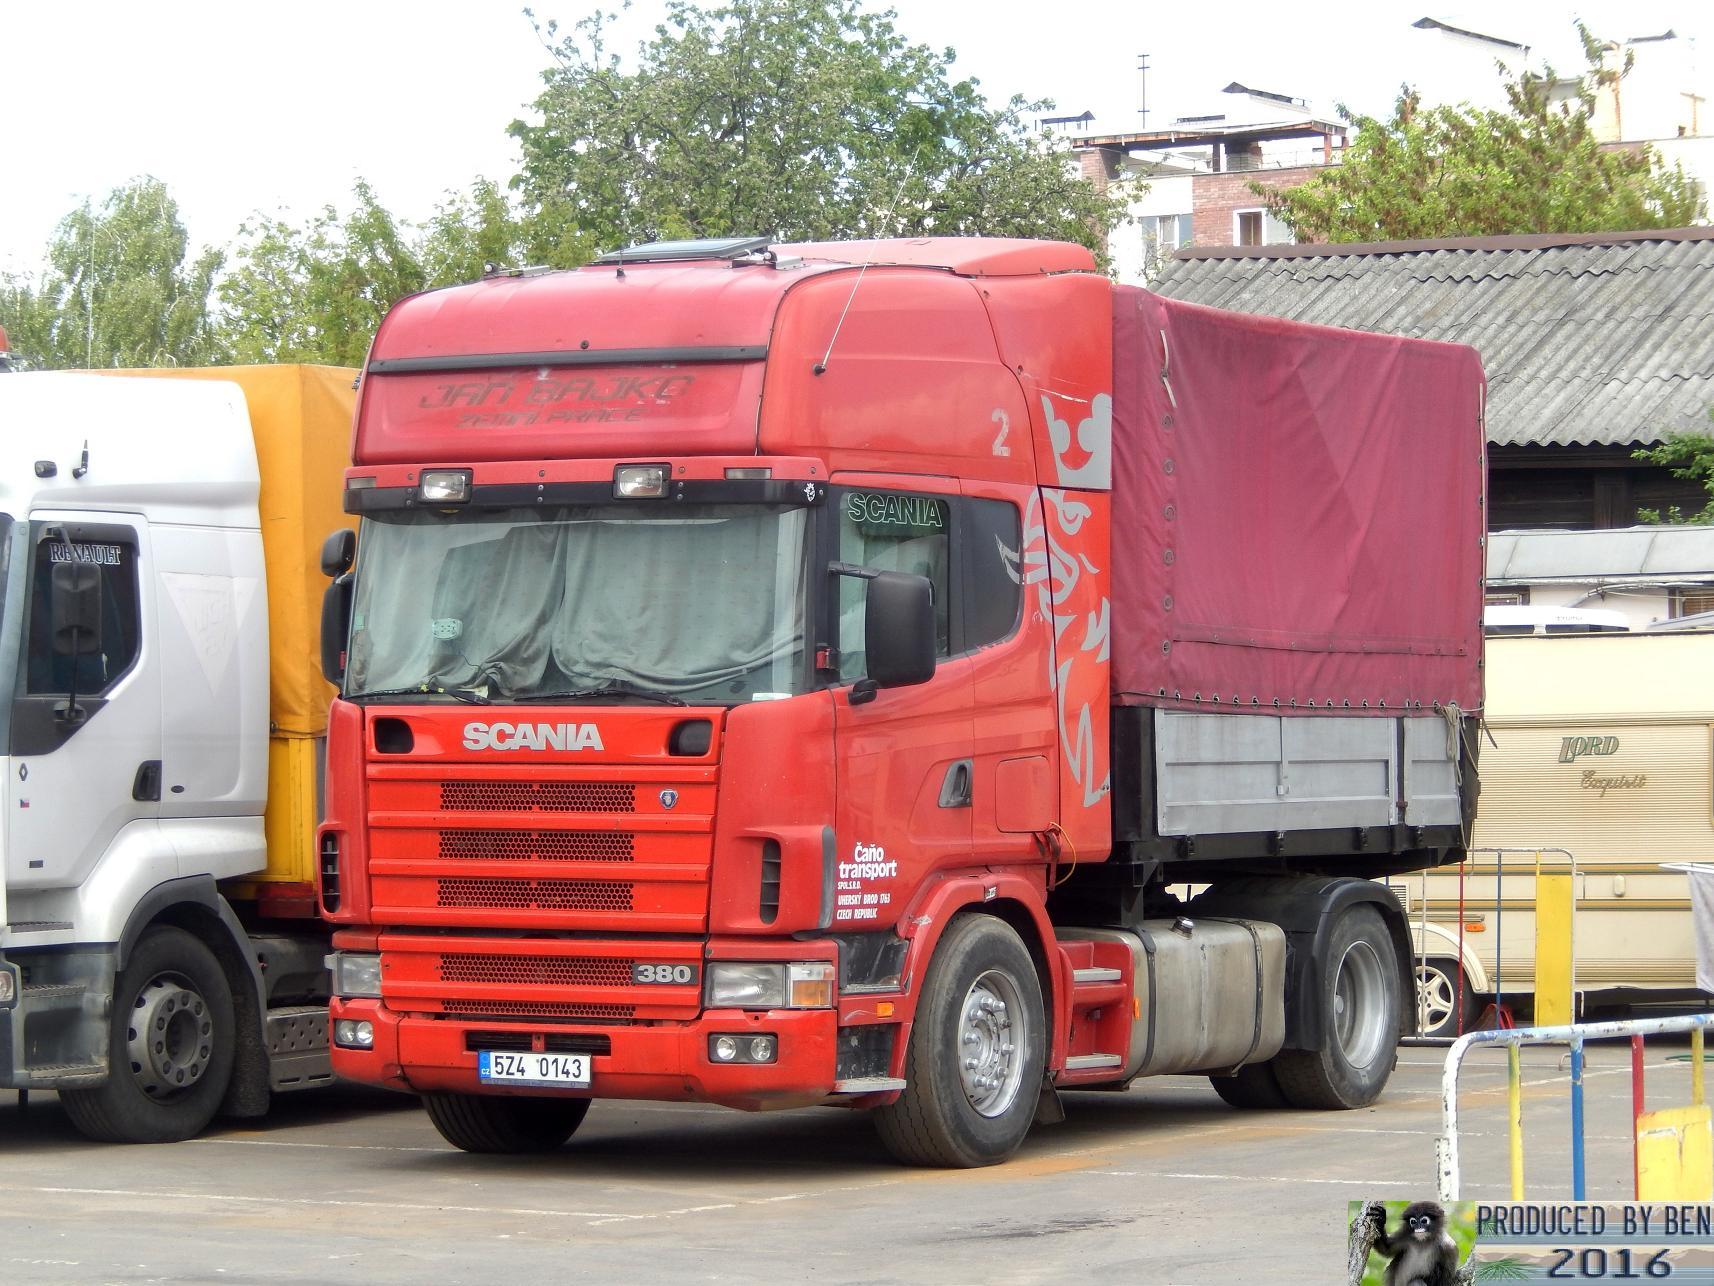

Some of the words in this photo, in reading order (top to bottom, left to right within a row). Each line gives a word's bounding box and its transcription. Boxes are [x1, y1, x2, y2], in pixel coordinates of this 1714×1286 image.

[991, 408, 1011, 457] 2
[847, 493, 943, 527] SCANIA
[49, 542, 122, 565] RENAULT
[462, 721, 605, 751] SCANIA
[1558, 735, 1620, 763] LORD
[854, 841, 885, 862] Čaňo
[838, 859, 898, 880] transport
[863, 893, 878, 904] BROD
[836, 909, 852, 920] CZECH
[853, 908, 878, 919] REPUBLIC
[637, 965, 691, 983] 380
[494, 1055, 526, 1077] 5Z4
[539, 1057, 582, 1079] 0143
